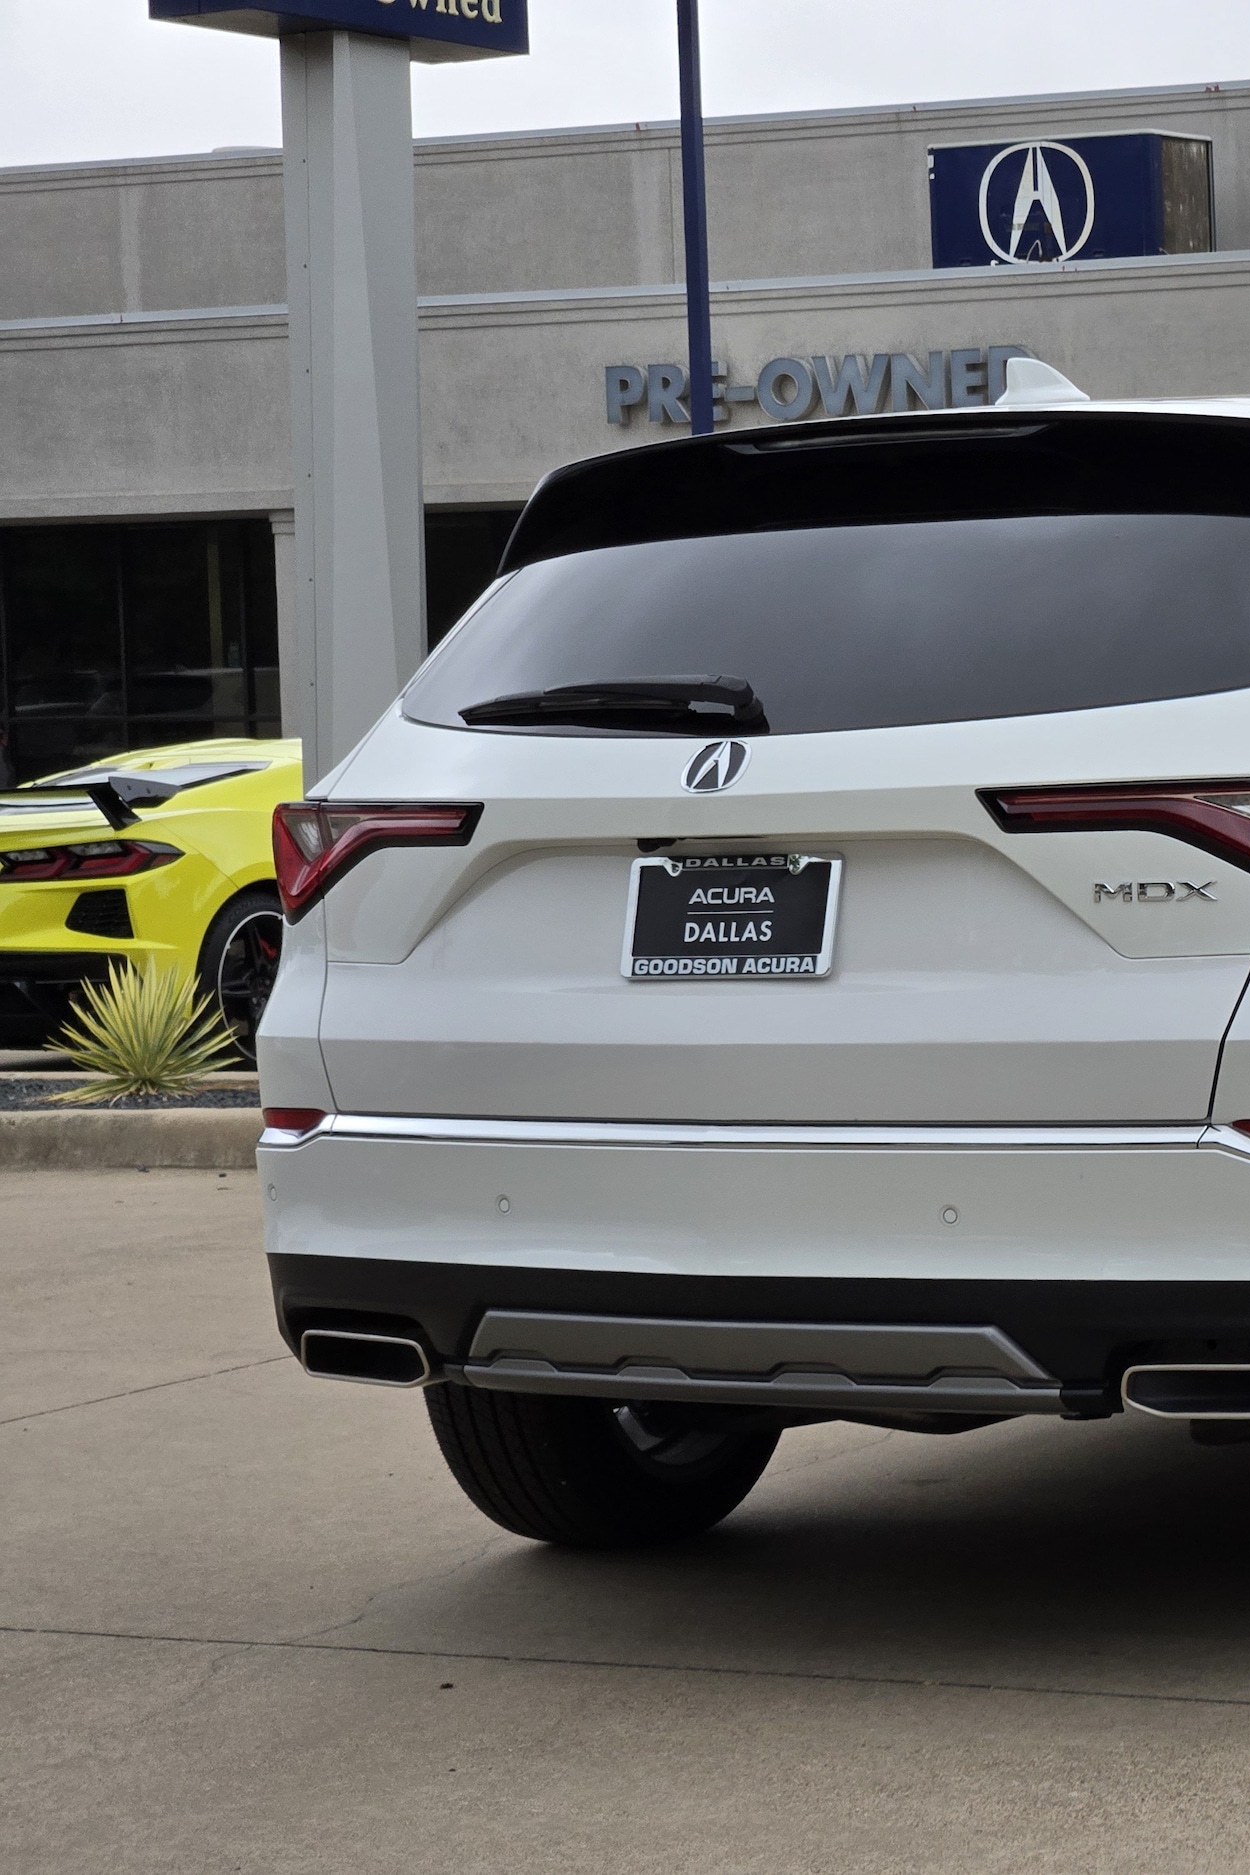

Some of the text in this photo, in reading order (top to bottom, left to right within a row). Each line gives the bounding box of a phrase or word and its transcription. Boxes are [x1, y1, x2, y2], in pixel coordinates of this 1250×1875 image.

[686, 856, 785, 869] DALLAS
[688, 886, 775, 905] ACURA
[1093, 880, 1219, 903] MDX
[684, 920, 773, 943] DALLAS
[634, 956, 814, 975] GOODSON ACURA
